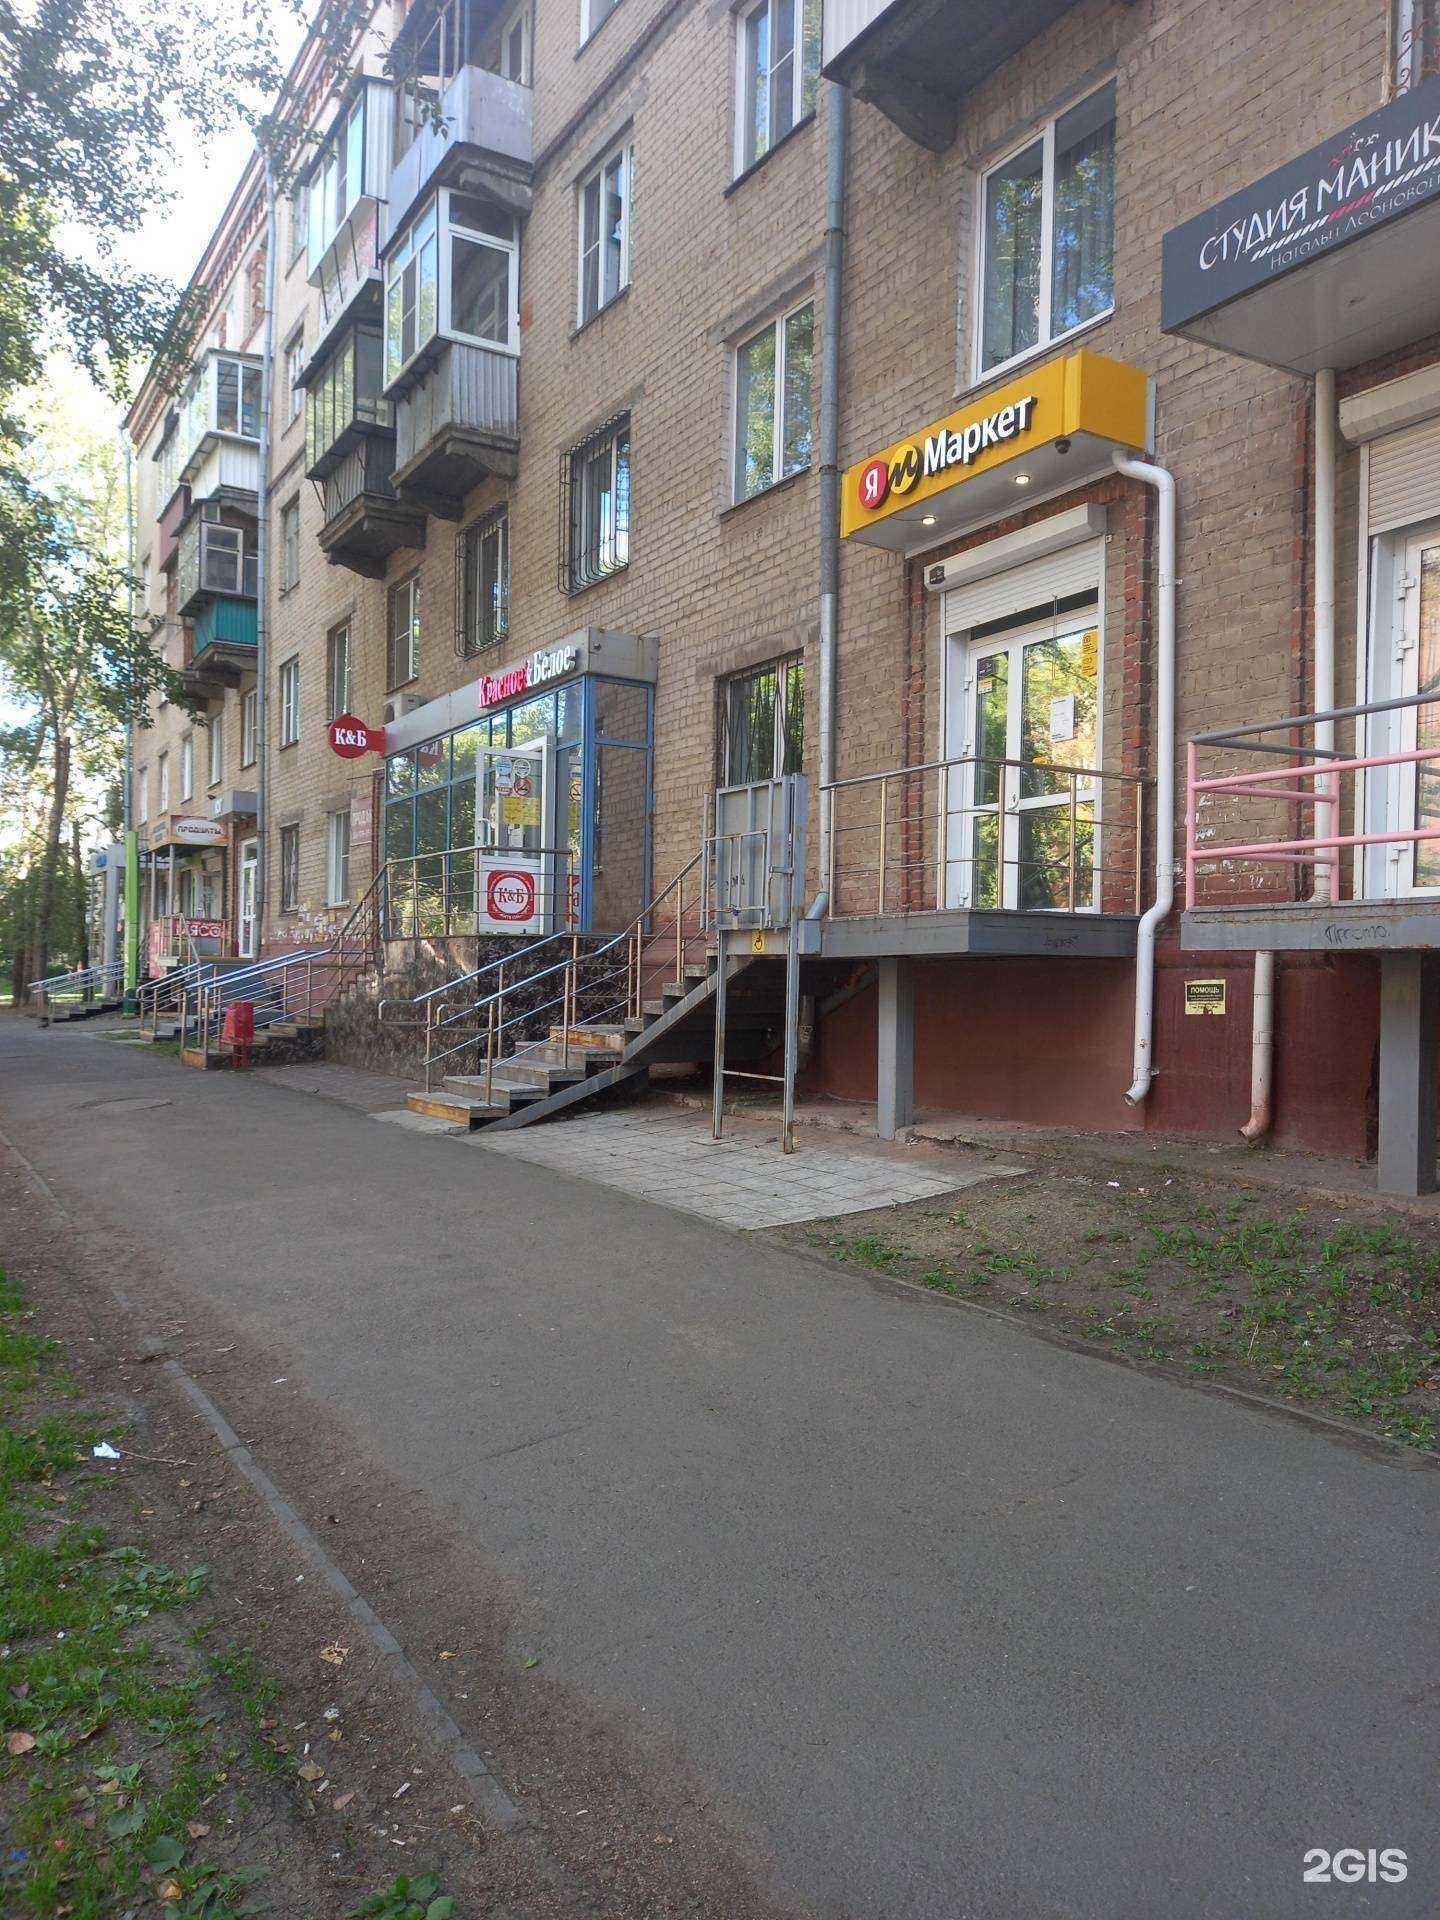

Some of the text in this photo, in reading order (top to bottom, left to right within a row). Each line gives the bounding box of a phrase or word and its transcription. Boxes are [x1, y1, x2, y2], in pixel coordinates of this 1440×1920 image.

[1200, 186, 1309, 270] СТУДИЯ
[923, 395, 1035, 477] Маркет
[334, 727, 367, 747] К&Б
[498, 887, 524, 904] К&Б
[1190, 986, 1220, 994] ПОМОЩЬ
